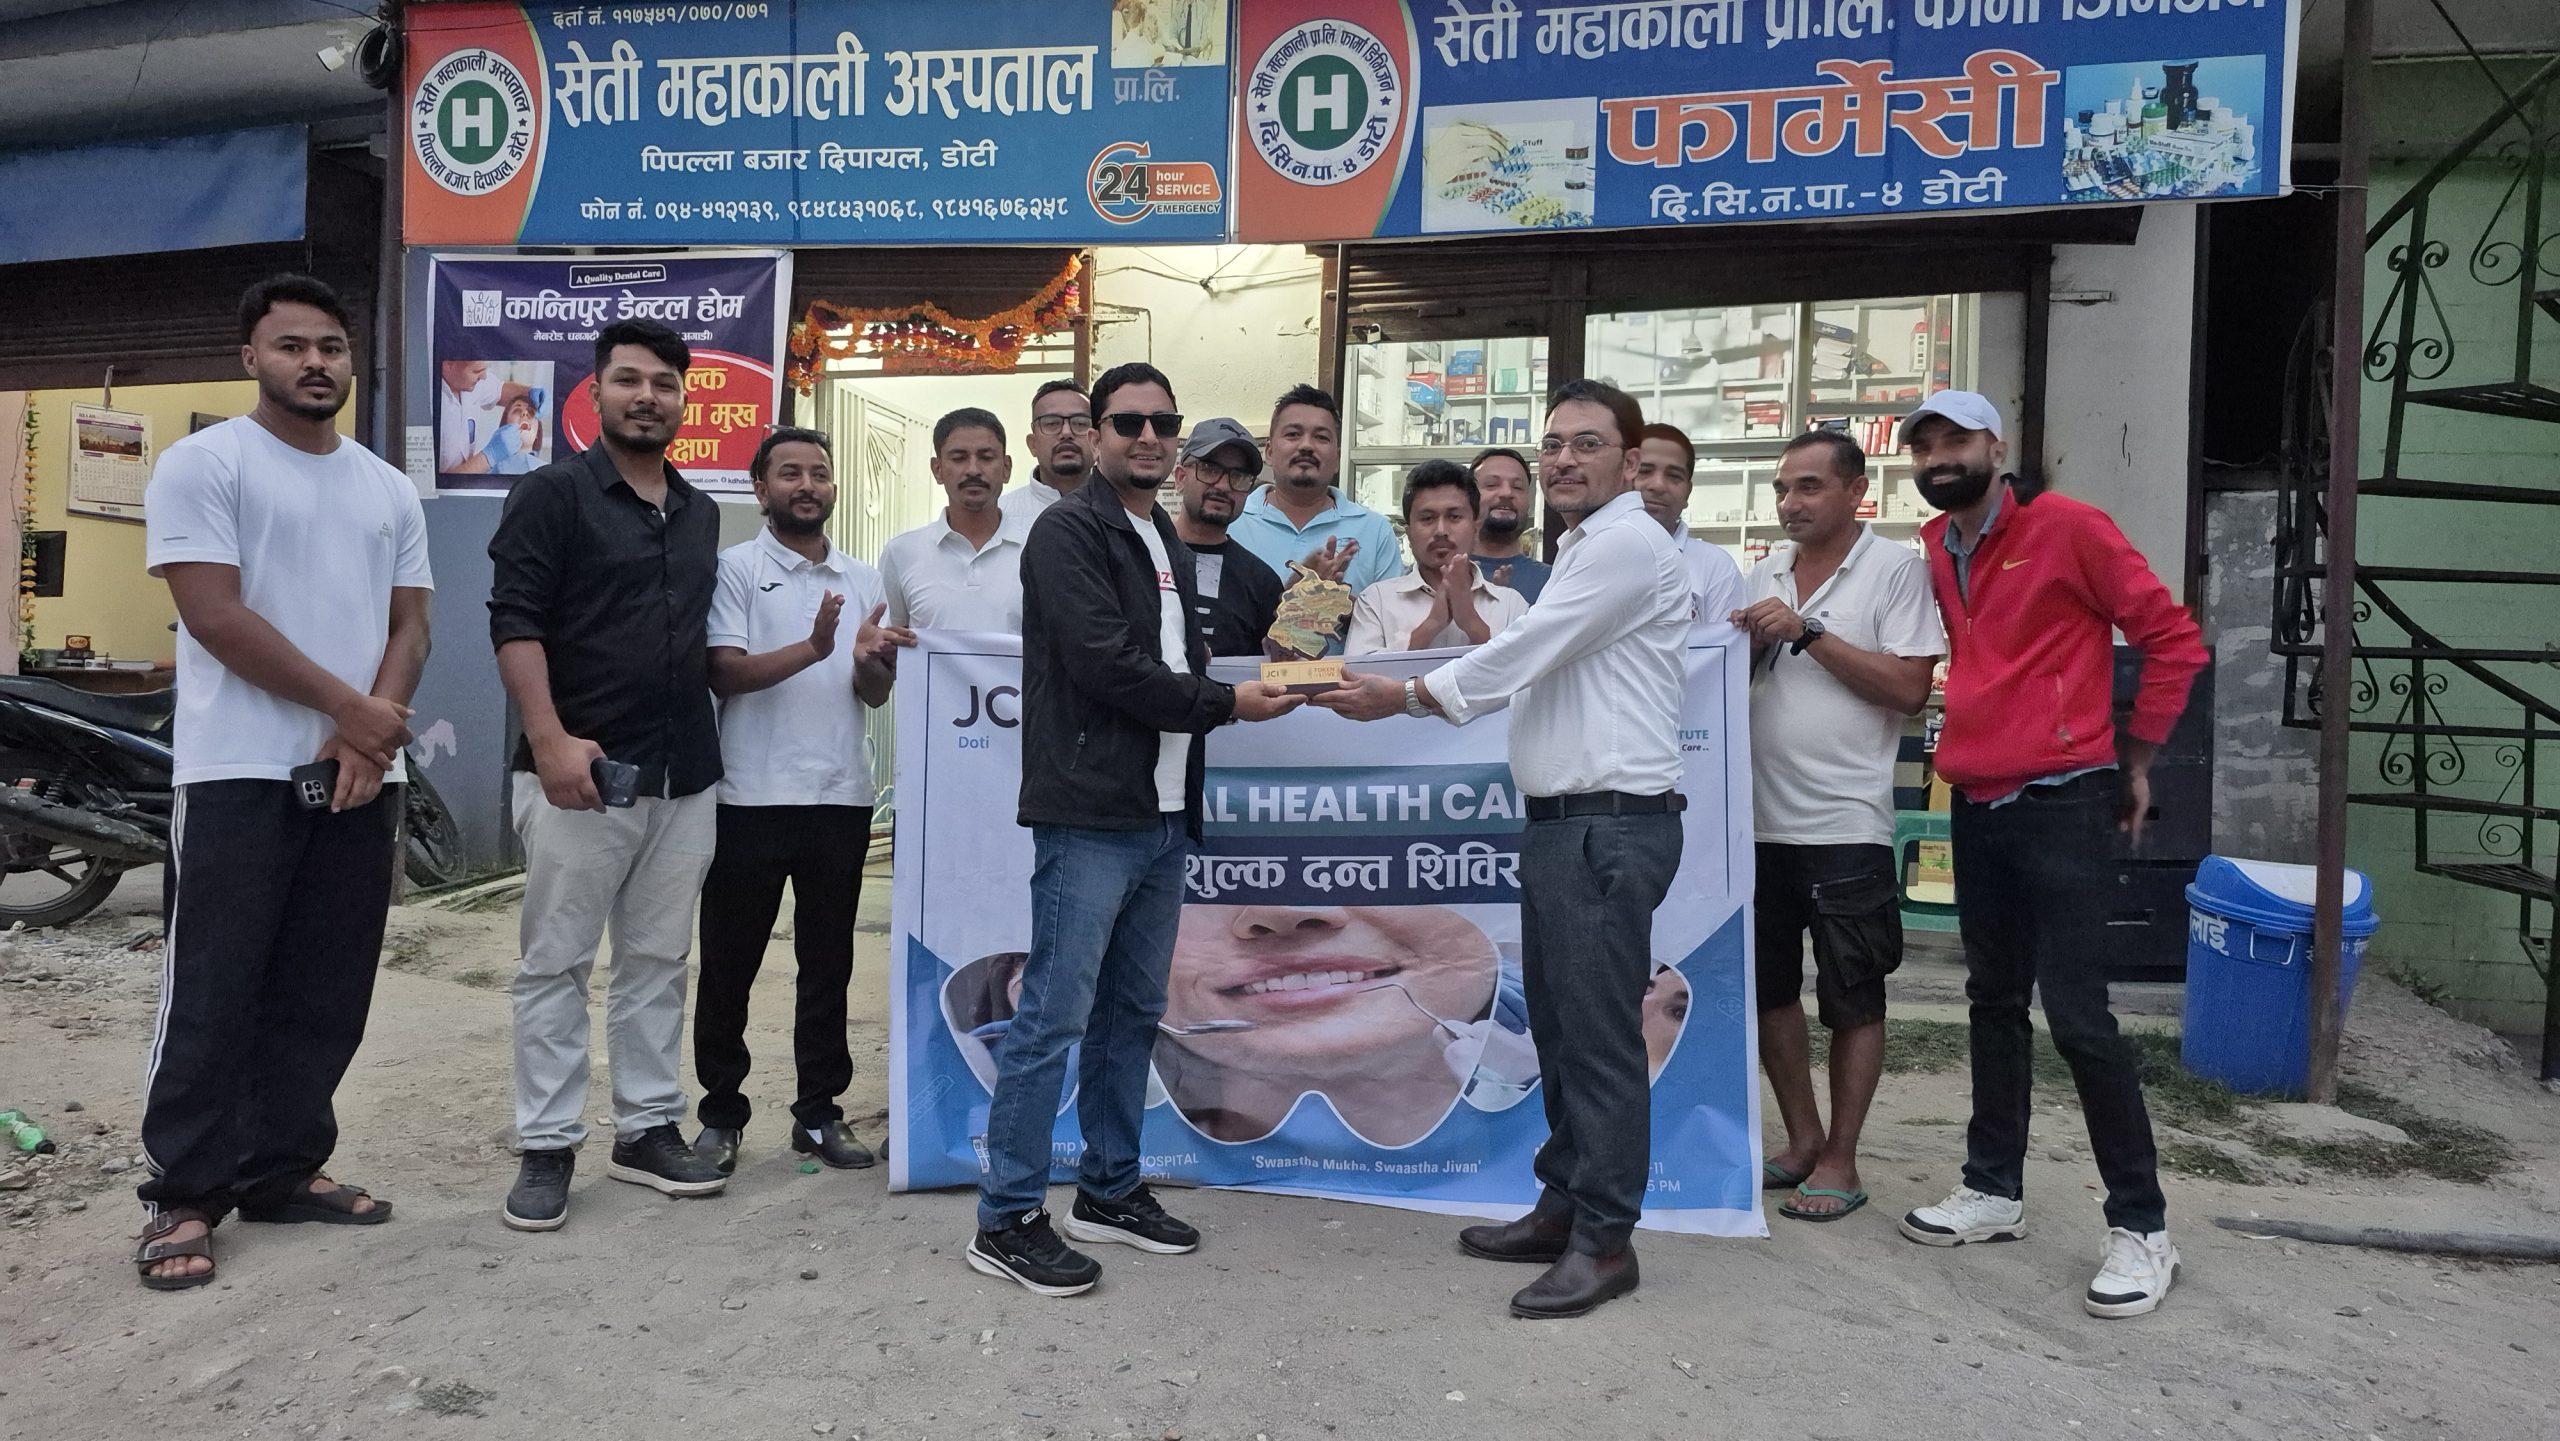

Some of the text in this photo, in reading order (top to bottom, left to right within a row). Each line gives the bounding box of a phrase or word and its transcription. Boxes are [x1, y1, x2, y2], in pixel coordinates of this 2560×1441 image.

[588, 7, 606, 26] नं.
[1433, 0, 1522, 67] सेती
[555, 31, 1180, 127] सेती महाकाली अस्पताल प्रा.लि.
[1251, 72, 1275, 99] सेती
[1266, 30, 1308, 73] महाकाली
[1340, 29, 1370, 54] फार्मा
[416, 50, 531, 115] सेती महाकाली अस्पताल
[1600, 49, 2061, 169] फार्मेसी
[1358, 115, 1388, 161] डोटी
[417, 133, 446, 178] पिपल्ला
[443, 168, 471, 191] बजार
[506, 131, 529, 161] डोटी
[642, 139, 999, 175] पिपल्ला बजार दिपायल, डोटी
[1096, 164, 1185, 203] 24 hour
[1156, 184, 1211, 195] SERVICE
[1922, 167, 2008, 204] डोटी
[580, 197, 621, 221] फोन
[627, 197, 648, 221] नं.
[1156, 204, 1221, 213] EMERGENCY
[576, 269, 661, 284] A Quality Dental Care
[504, 287, 745, 327] कान्तिपुर डेन्टल होम
[710, 403, 759, 433] मुख
[1266, 670, 1279, 678] JCI
[952, 685, 1020, 728] JC
[958, 735, 990, 749] Doti
[1679, 729, 1709, 740] TUTE
[1248, 784, 1430, 822] HEALTH
[1442, 783, 1526, 820] CA
[1184, 854, 1288, 898] शुल्क
[1301, 853, 1393, 893] दन्त
[1052, 1141, 1076, 1155] mp
[1375, 1161, 1439, 1174] Swaastha
[1659, 1179, 1681, 1193] PM
